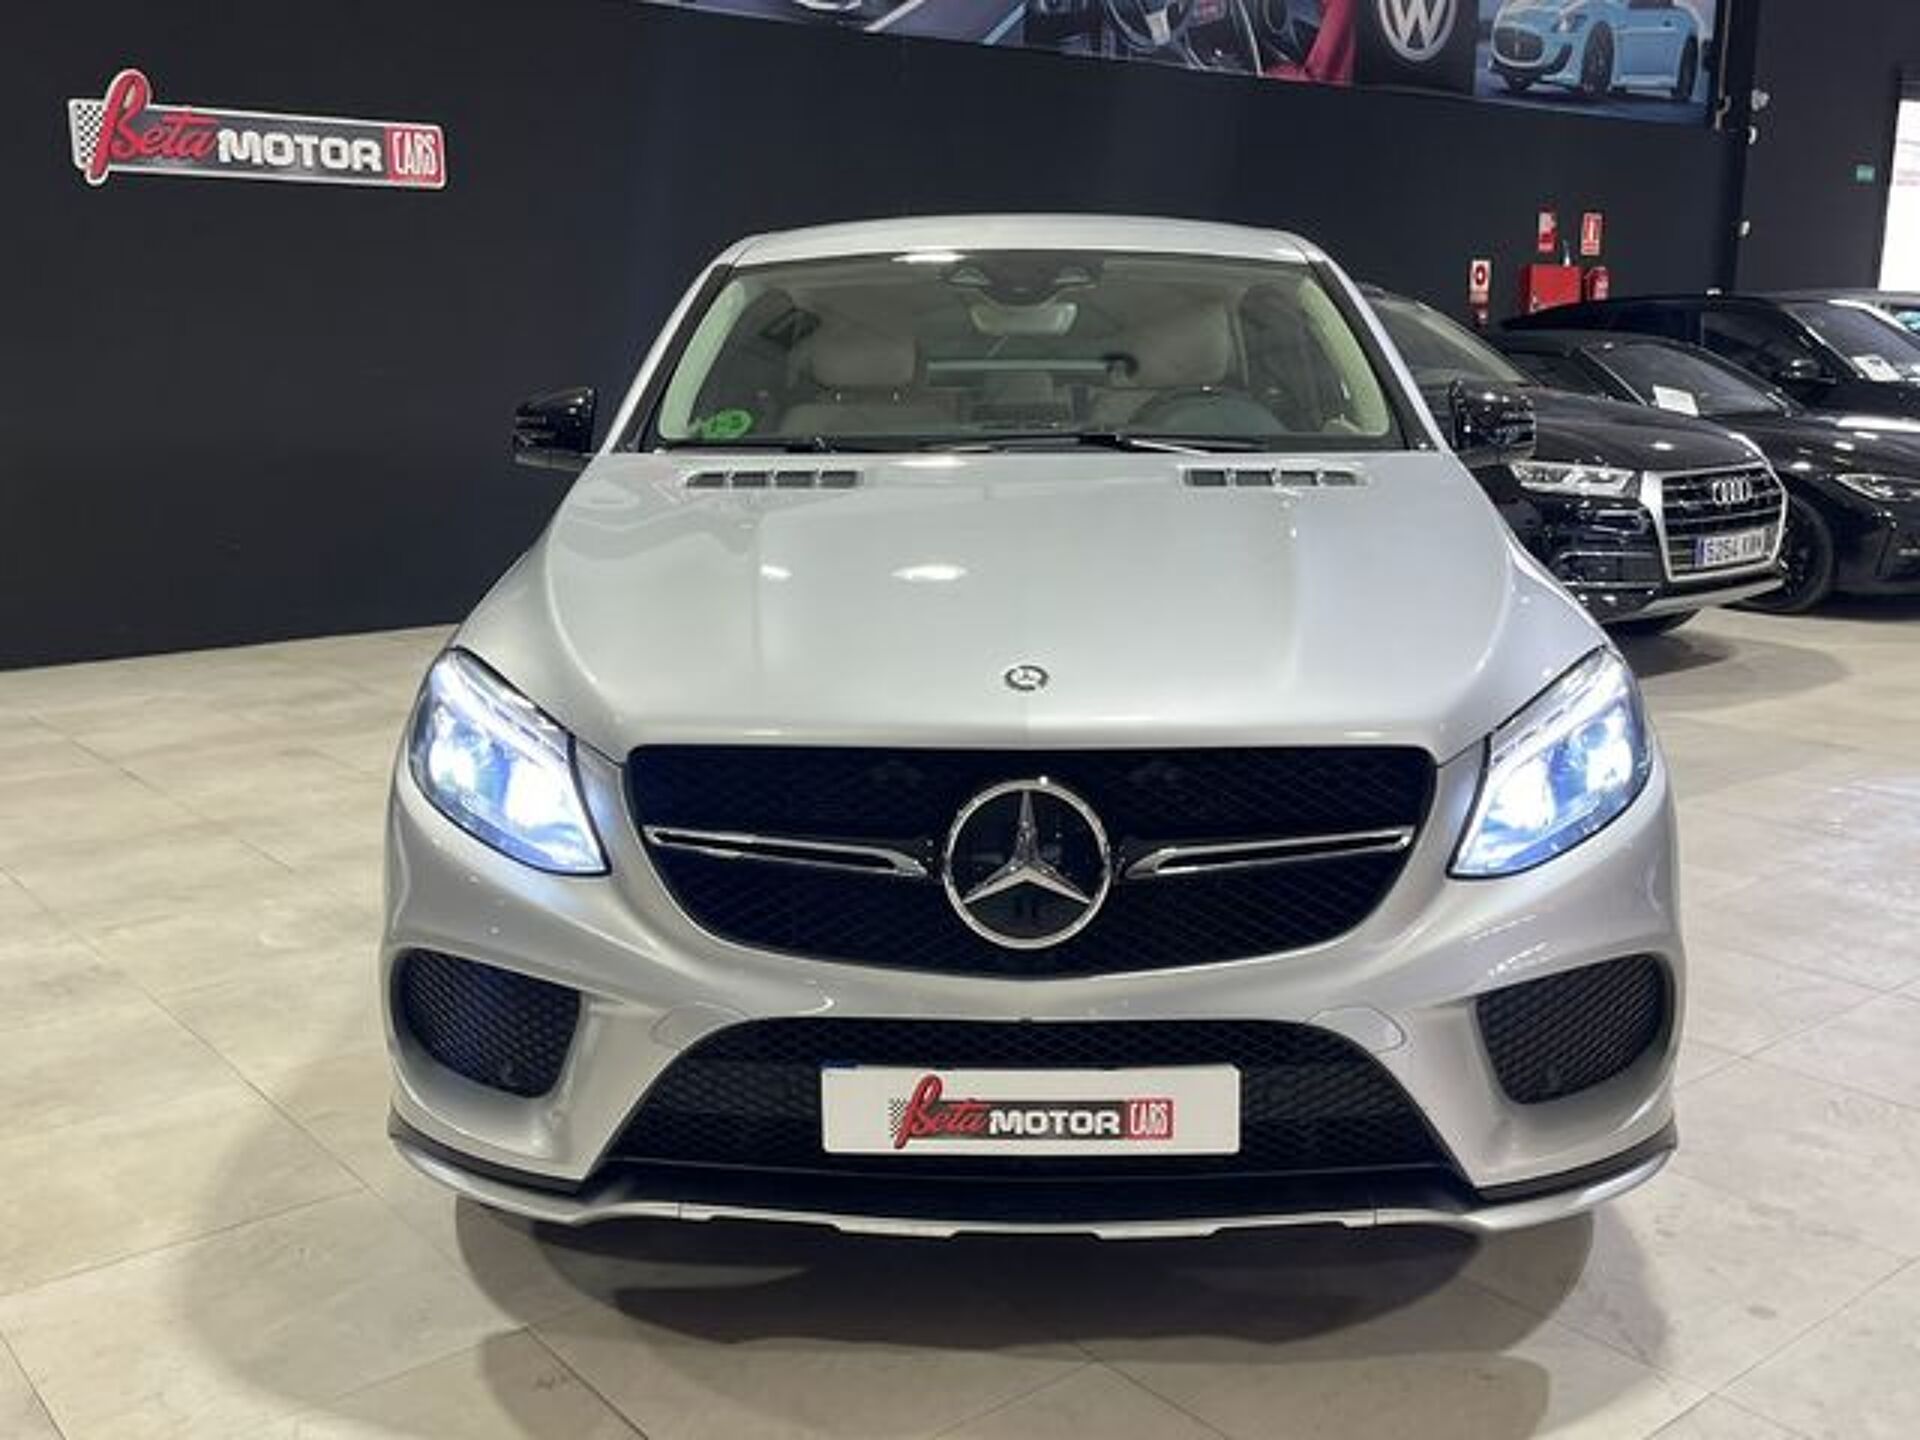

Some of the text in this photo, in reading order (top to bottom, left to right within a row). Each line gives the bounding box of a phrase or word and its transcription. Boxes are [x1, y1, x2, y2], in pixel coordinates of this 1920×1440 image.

[218, 129, 384, 172] MOTOR
[391, 130, 439, 176] CARS
[989, 1109, 1121, 1135] MOTOR
[1129, 1103, 1170, 1135] CARS
